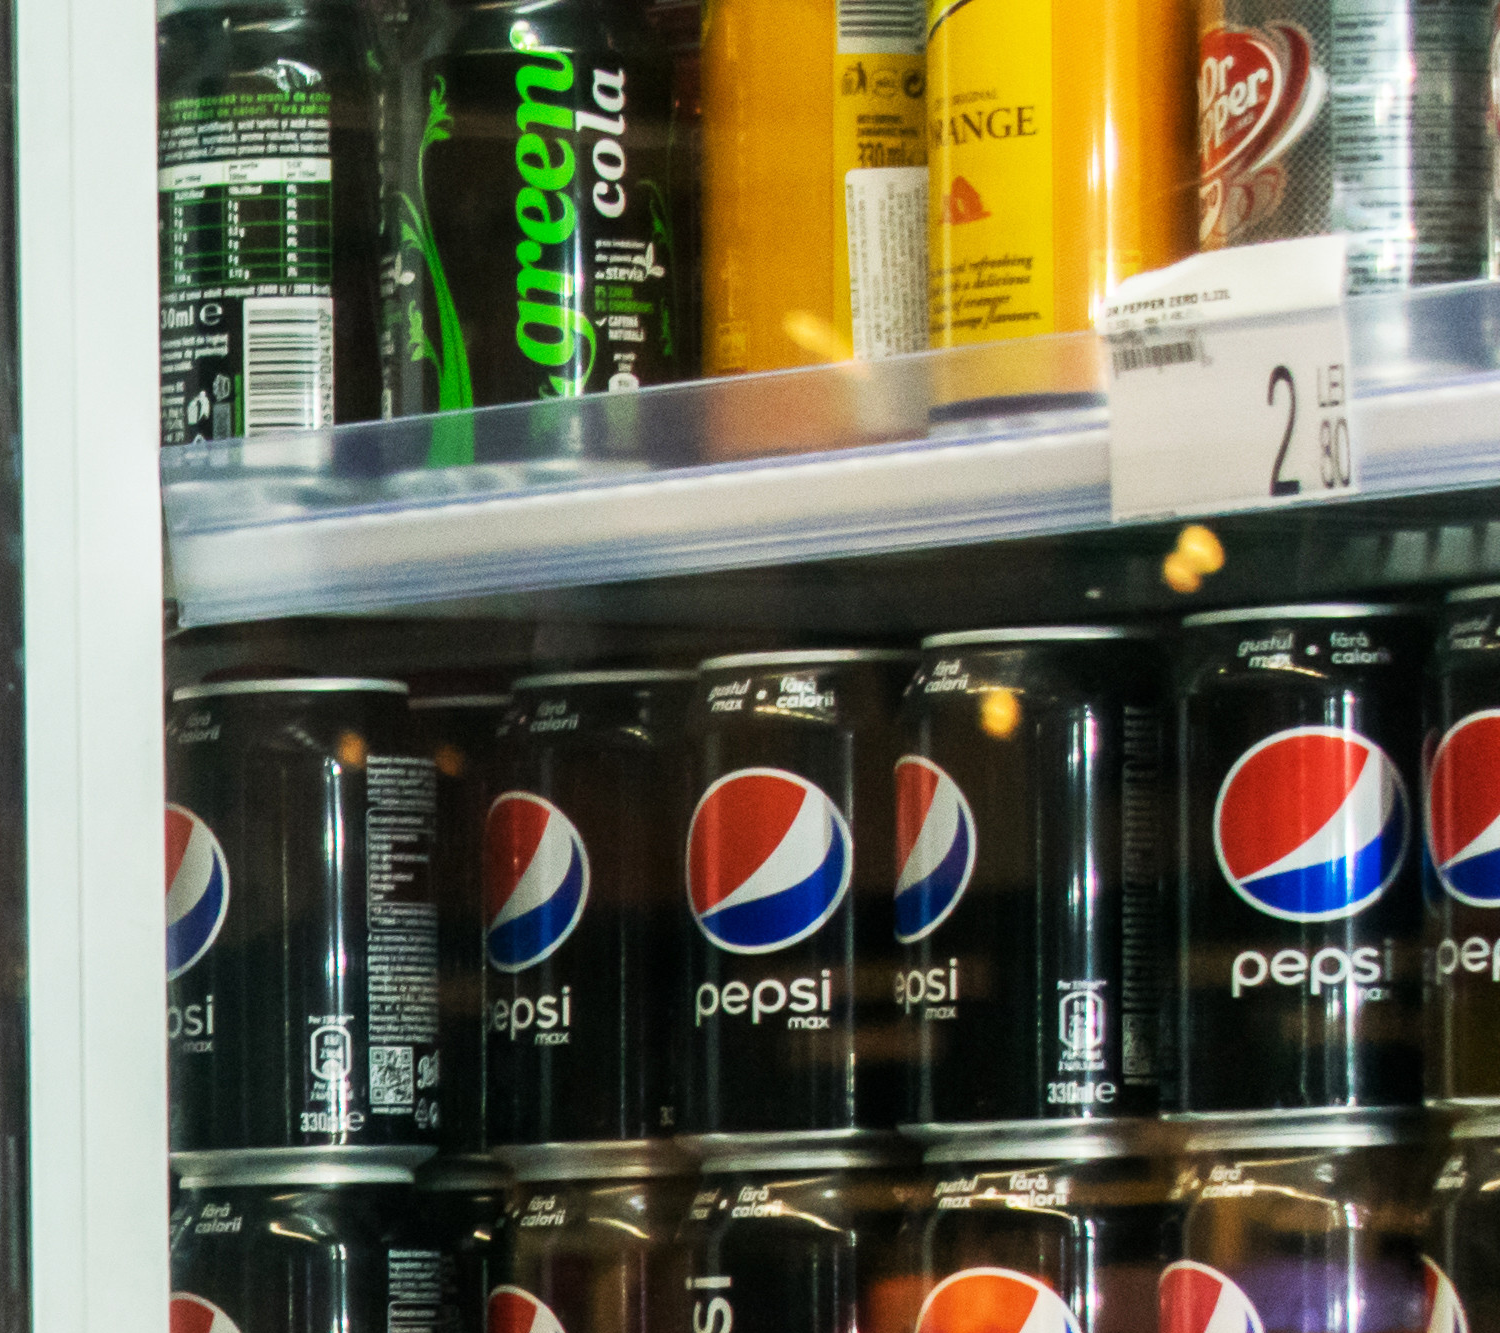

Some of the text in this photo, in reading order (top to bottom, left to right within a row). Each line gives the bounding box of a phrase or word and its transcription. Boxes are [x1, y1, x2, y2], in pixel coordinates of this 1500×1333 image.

[575, 67, 626, 219] cola
[514, 47, 597, 368] green
[1268, 364, 1346, 497] 2 LEI
[1319, 418, 1351, 490] 80
[1237, 632, 1294, 658] gustul
[1231, 937, 1395, 999] pepsi
[487, 985, 571, 1042] epsi
[695, 969, 832, 1027] pepsi
[787, 1013, 830, 1031] max
[925, 1004, 957, 1020] max
[534, 1030, 570, 1046] max
